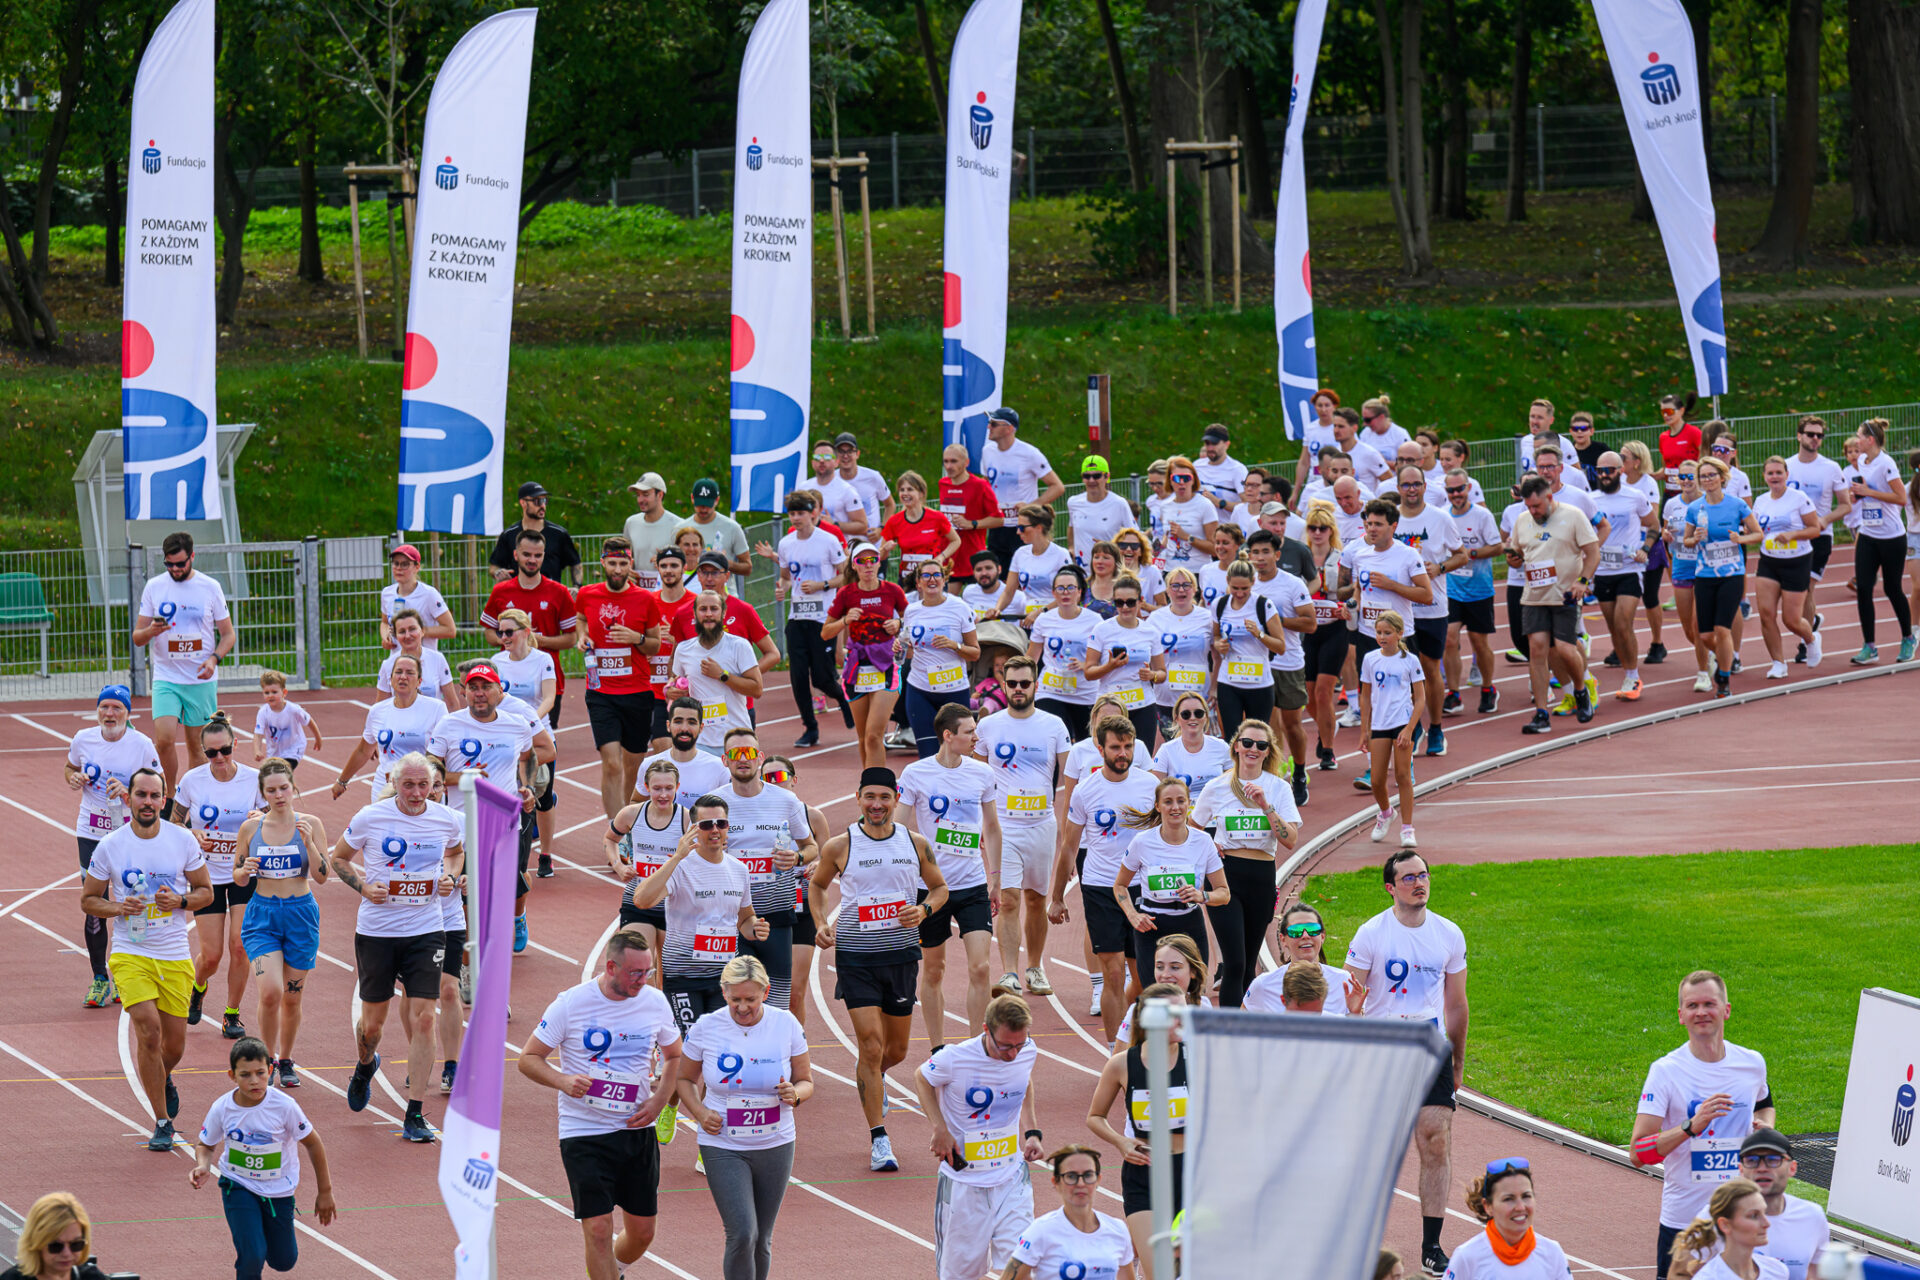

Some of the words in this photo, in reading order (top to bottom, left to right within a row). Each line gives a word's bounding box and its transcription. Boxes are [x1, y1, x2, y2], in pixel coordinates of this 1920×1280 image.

[167, 156, 206, 170] Fundacja
[767, 153, 803, 168] Fundacja
[980, 163, 1000, 179] olski
[466, 174, 509, 190] Fundacja
[141, 218, 208, 232] POMAGAMY
[744, 214, 806, 229] POMAGAMY
[141, 235, 147, 248] Z
[151, 234, 199, 249] KAŻDYM
[431, 233, 507, 252] POMAGAMY
[744, 231, 750, 243] Z
[752, 232, 797, 246] KAŻDYM
[141, 253, 193, 266] KROKIEM
[429, 250, 437, 262] Z
[441, 251, 495, 268] KAŻDYM
[744, 249, 791, 262] KROKIEM
[428, 267, 487, 283] KROKIEM
[1004, 509, 1018, 518] 19/
[797, 602, 817, 612] 36/3
[1316, 608, 1332, 618] 2/5
[1365, 610, 1379, 619] 33/
[178, 642, 194, 652] 5/2
[601, 658, 625, 668] 89/3
[1233, 664, 1256, 674] 63/3
[935, 670, 957, 683] 63/1
[1048, 675, 1063, 687] 63/
[1176, 672, 1199, 682] 63/5
[703, 706, 719, 717] 7/2
[1015, 797, 1040, 810] 21/4
[1234, 818, 1262, 831] 13/1
[946, 832, 972, 846] 13/5
[213, 842, 237, 854] 26/2
[264, 857, 292, 869] 46/1
[746, 860, 766, 873] 0/2
[398, 883, 427, 896] 26/5
[1158, 877, 1177, 889] 13/
[869, 905, 897, 920] 10/3
[705, 938, 729, 951] 10/1
[601, 1084, 626, 1100] 2/5
[743, 1111, 766, 1125] 2/1
[976, 1141, 1008, 1158] 49/2
[245, 1156, 264, 1169] 98
[1704, 1153, 1740, 1169] 32/4
[1877, 1159, 1893, 1178] Bank
[1893, 1164, 1911, 1184] Polski
